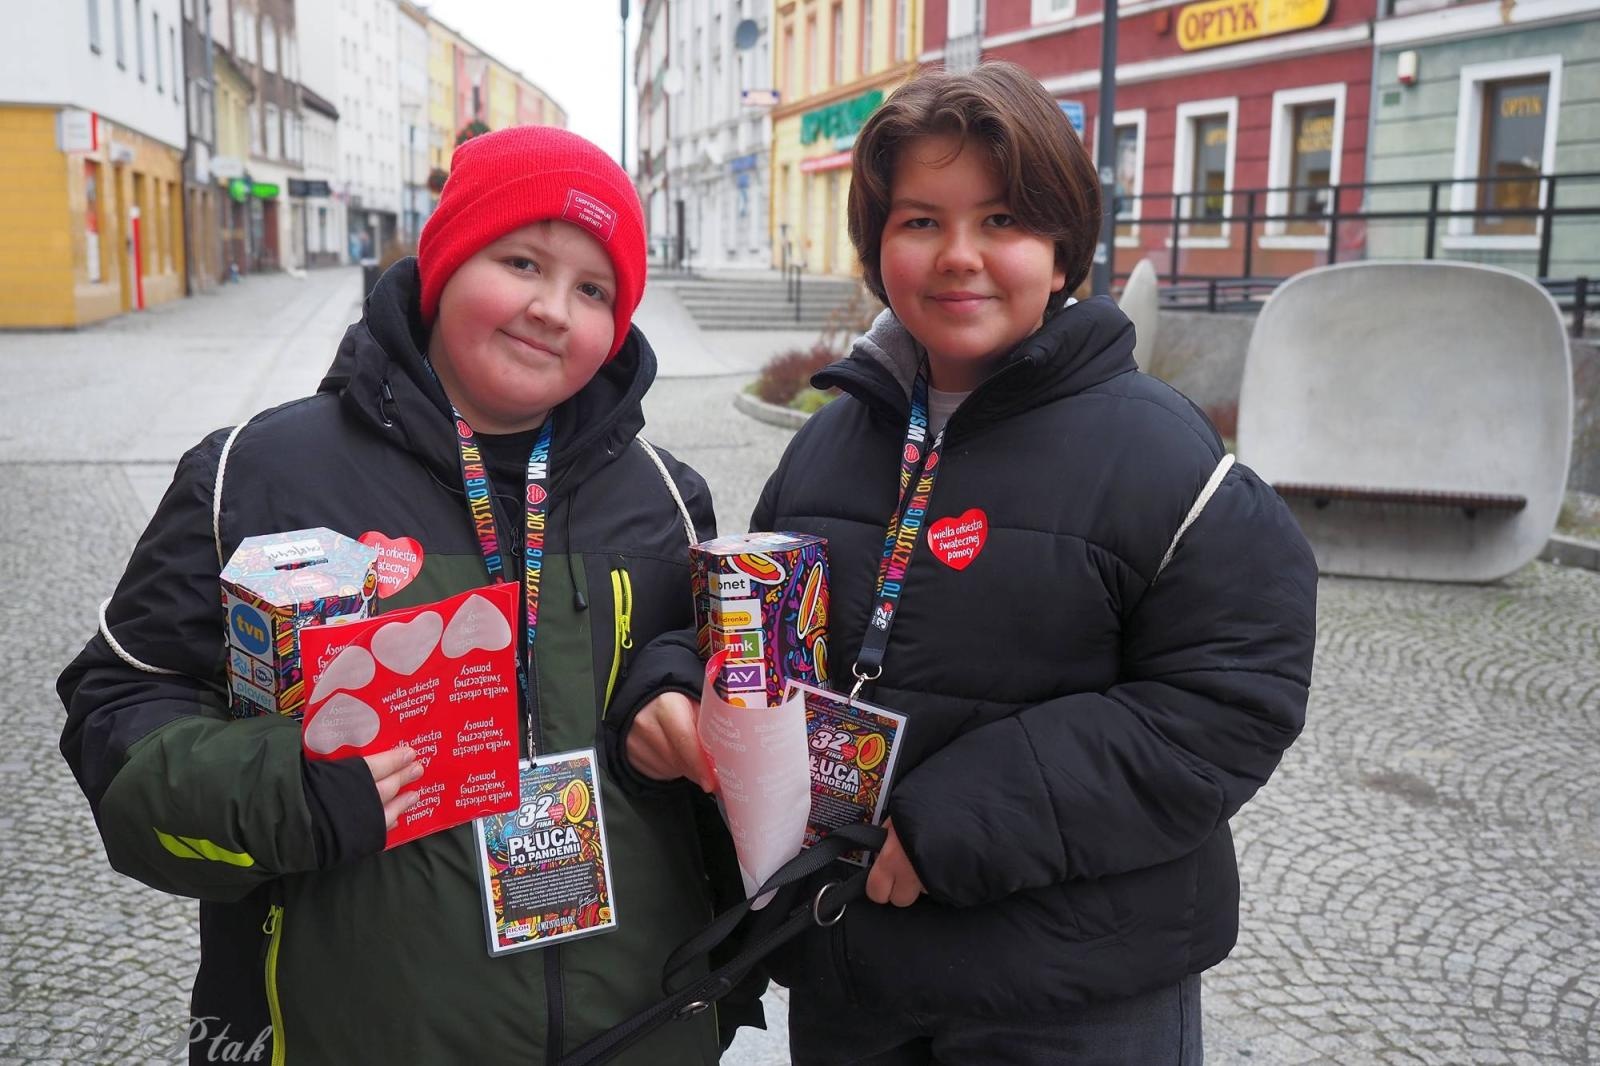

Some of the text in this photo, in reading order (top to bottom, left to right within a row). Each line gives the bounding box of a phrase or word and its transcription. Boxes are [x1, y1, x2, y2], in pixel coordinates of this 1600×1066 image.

[1184, 1, 1258, 42] OPTYK
[916, 473, 935, 493] OK!
[461, 442, 503, 574] TU WSZYSTKO GRA OK!
[907, 495, 929, 516] GRA
[527, 507, 546, 530] OK!
[933, 519, 983, 540] wielka orkiestra
[527, 534, 545, 557] GRA
[886, 518, 920, 579] WSZYSTKO
[939, 532, 980, 551] świątecznej
[386, 547, 417, 563] orkiestra
[947, 548, 974, 562] pomocy
[377, 561, 410, 579] ątecznej
[377, 574, 400, 589] omocy
[880, 582, 900, 597] TU
[526, 559, 542, 626] WSZYSTKO
[236, 614, 265, 642] tvn
[295, 615, 314, 629] 32
[461, 662, 492, 676] pomocy
[722, 670, 756, 683] LAY
[382, 678, 440, 705] wielka orkiestra
[454, 674, 501, 693] świątecznej
[482, 686, 509, 699] wielka
[389, 690, 436, 714] świątecznej
[449, 689, 482, 704] orkiestra
[399, 704, 429, 723] pomocy
[463, 717, 495, 731] pomocy
[410, 730, 442, 746] orkiestra
[457, 728, 504, 746] świątecznej
[811, 731, 851, 751] 32
[452, 740, 511, 757] wielka orkiestra
[467, 770, 496, 784] pomocy
[809, 755, 859, 786] ŁUCA
[460, 780, 506, 798] świątecznej
[455, 791, 513, 809] wielka orkiestra
[406, 807, 434, 826] pomocy
[519, 795, 553, 827] 32
[509, 826, 579, 856] PŁUCA
[510, 854, 526, 865] PO
[528, 843, 580, 861] PANDEMII
[506, 925, 530, 935] RICOH
